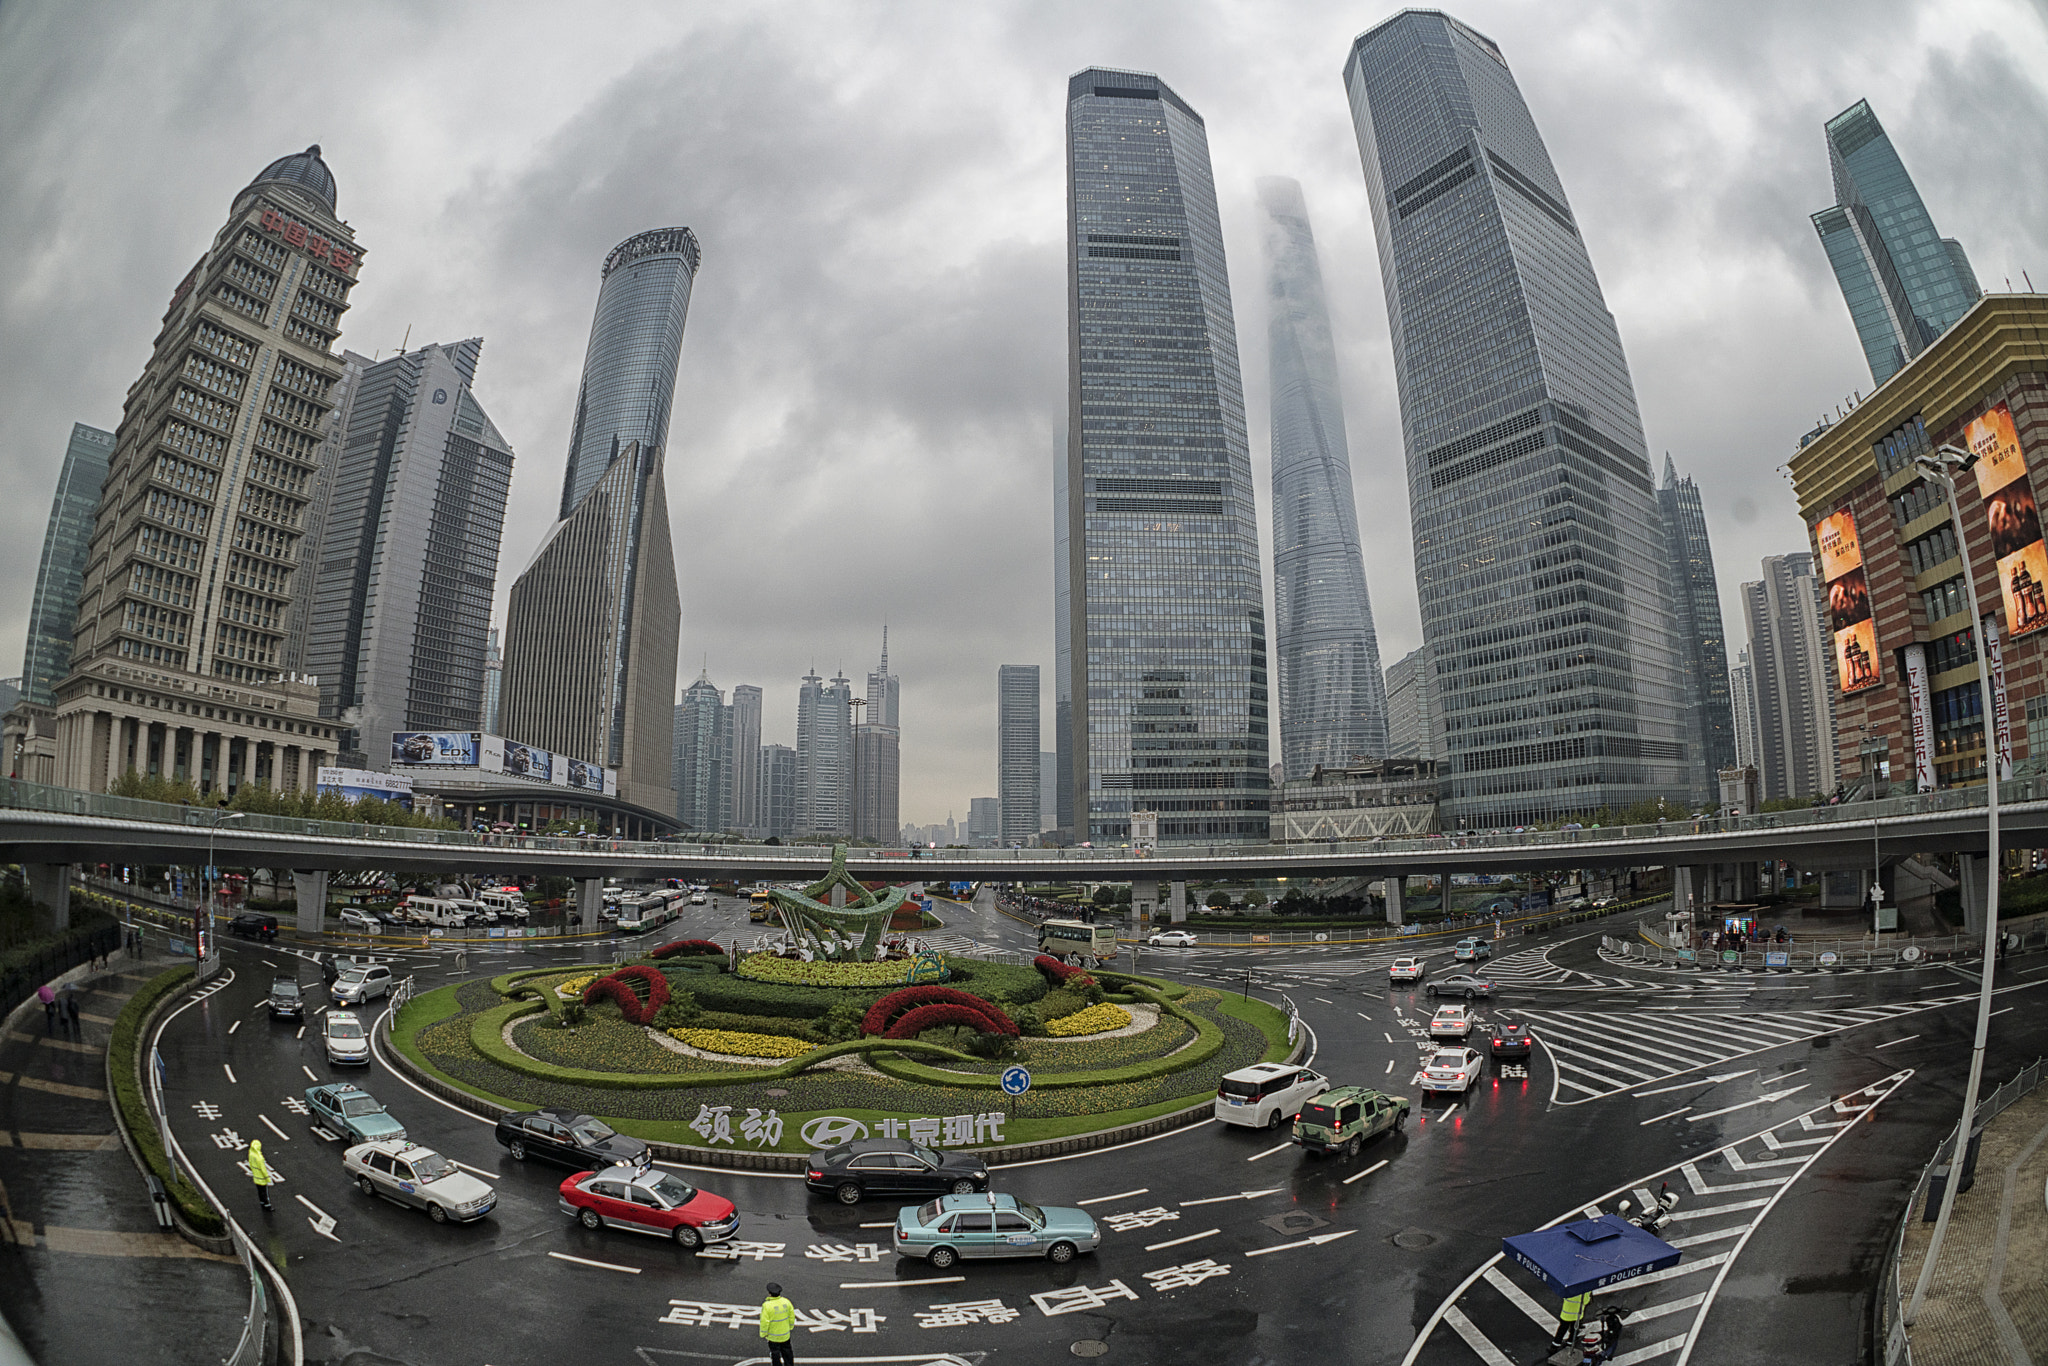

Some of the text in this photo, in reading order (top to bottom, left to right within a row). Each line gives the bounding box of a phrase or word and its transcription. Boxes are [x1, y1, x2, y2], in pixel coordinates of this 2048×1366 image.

[260, 209, 355, 274] 中国平安
[440, 748, 471, 757] CDX
[688, 1103, 784, 1148] 领动
[874, 1112, 1006, 1147] 北京现代
[1522, 1257, 1542, 1276] POLICE
[1610, 1266, 1642, 1284] POLICE
